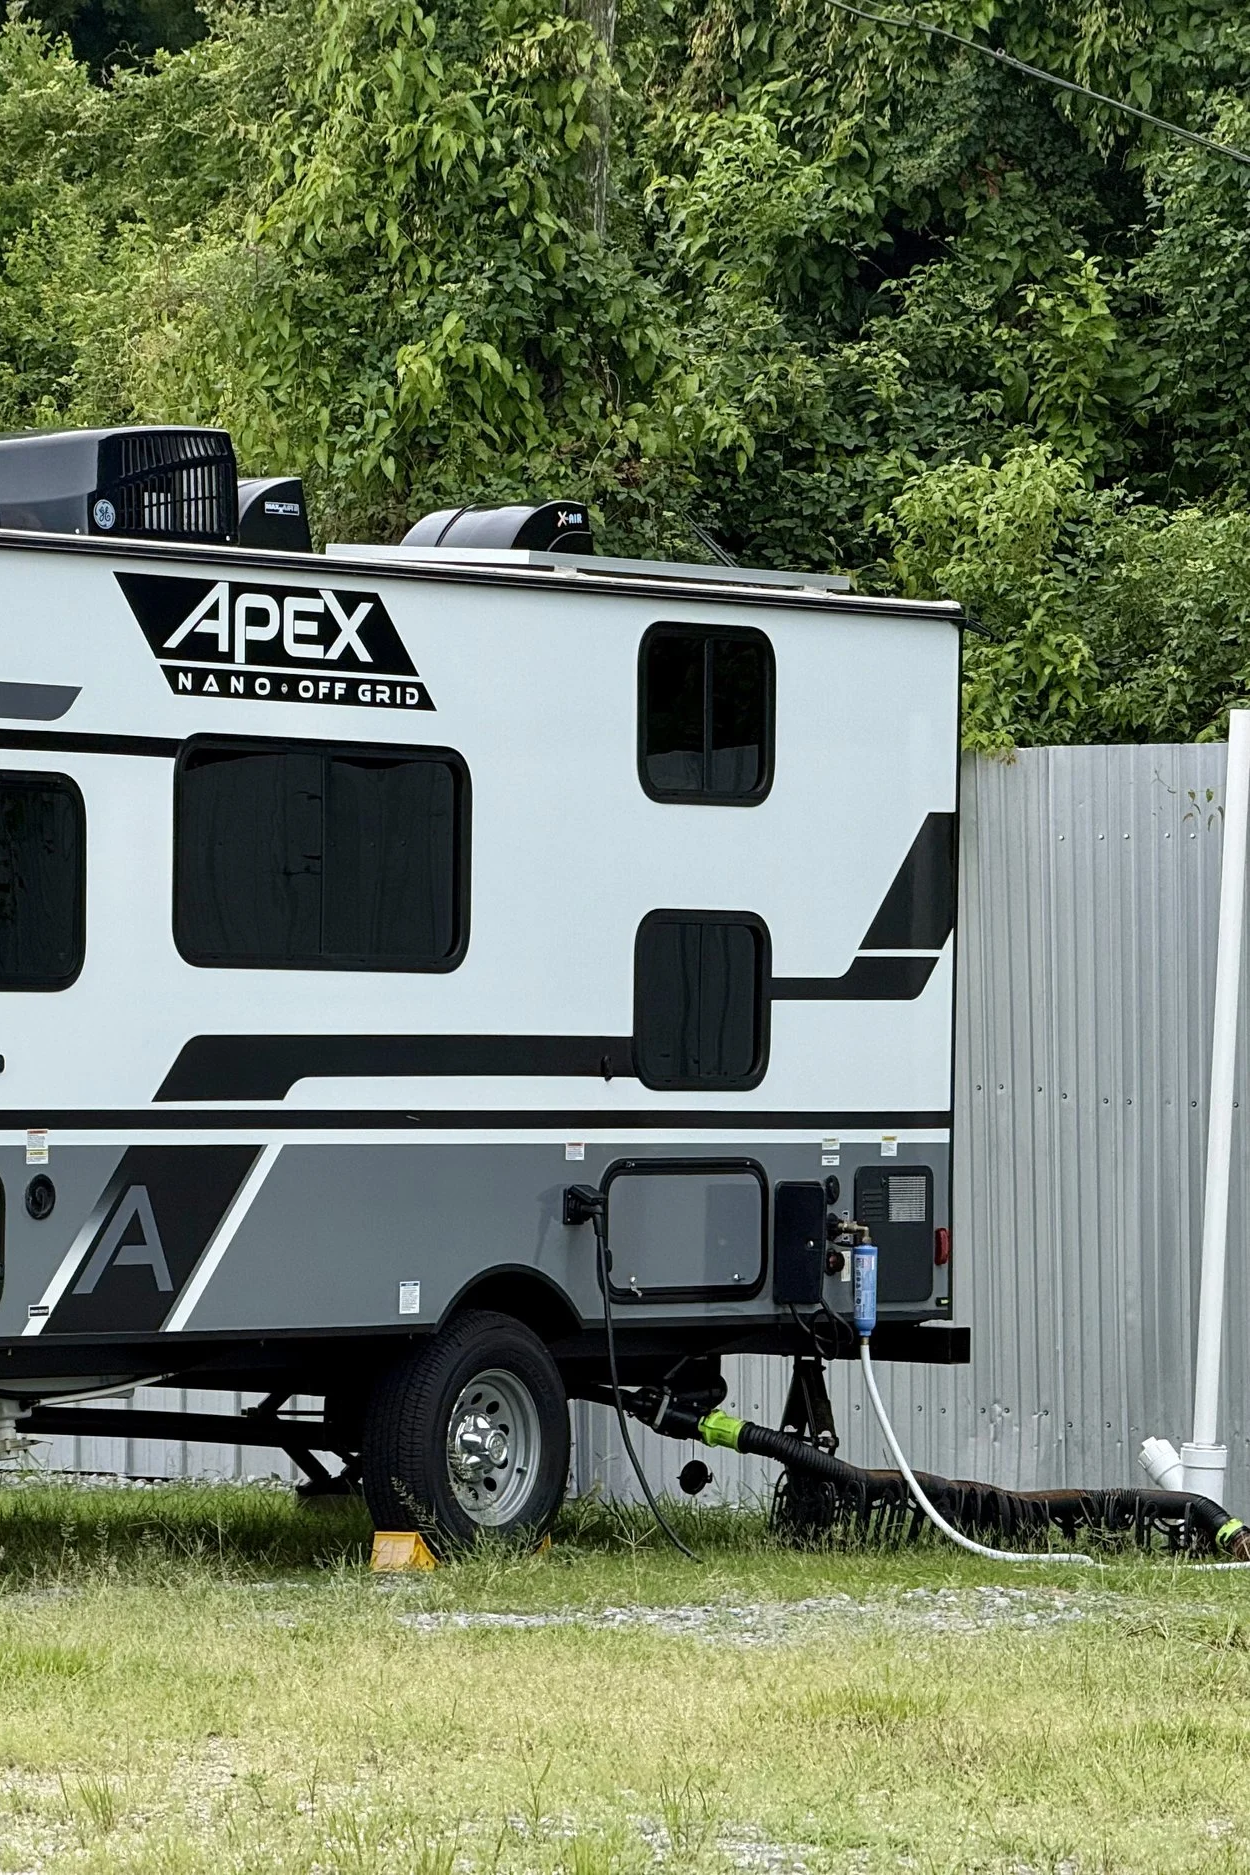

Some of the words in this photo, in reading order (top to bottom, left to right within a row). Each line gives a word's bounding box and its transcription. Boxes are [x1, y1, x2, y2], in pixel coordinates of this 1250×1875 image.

[557, 510, 583, 528] X-AIR
[162, 581, 375, 664] APEX
[177, 672, 272, 697] NANO
[298, 680, 347, 701] OFF
[357, 684, 420, 706] GRID
